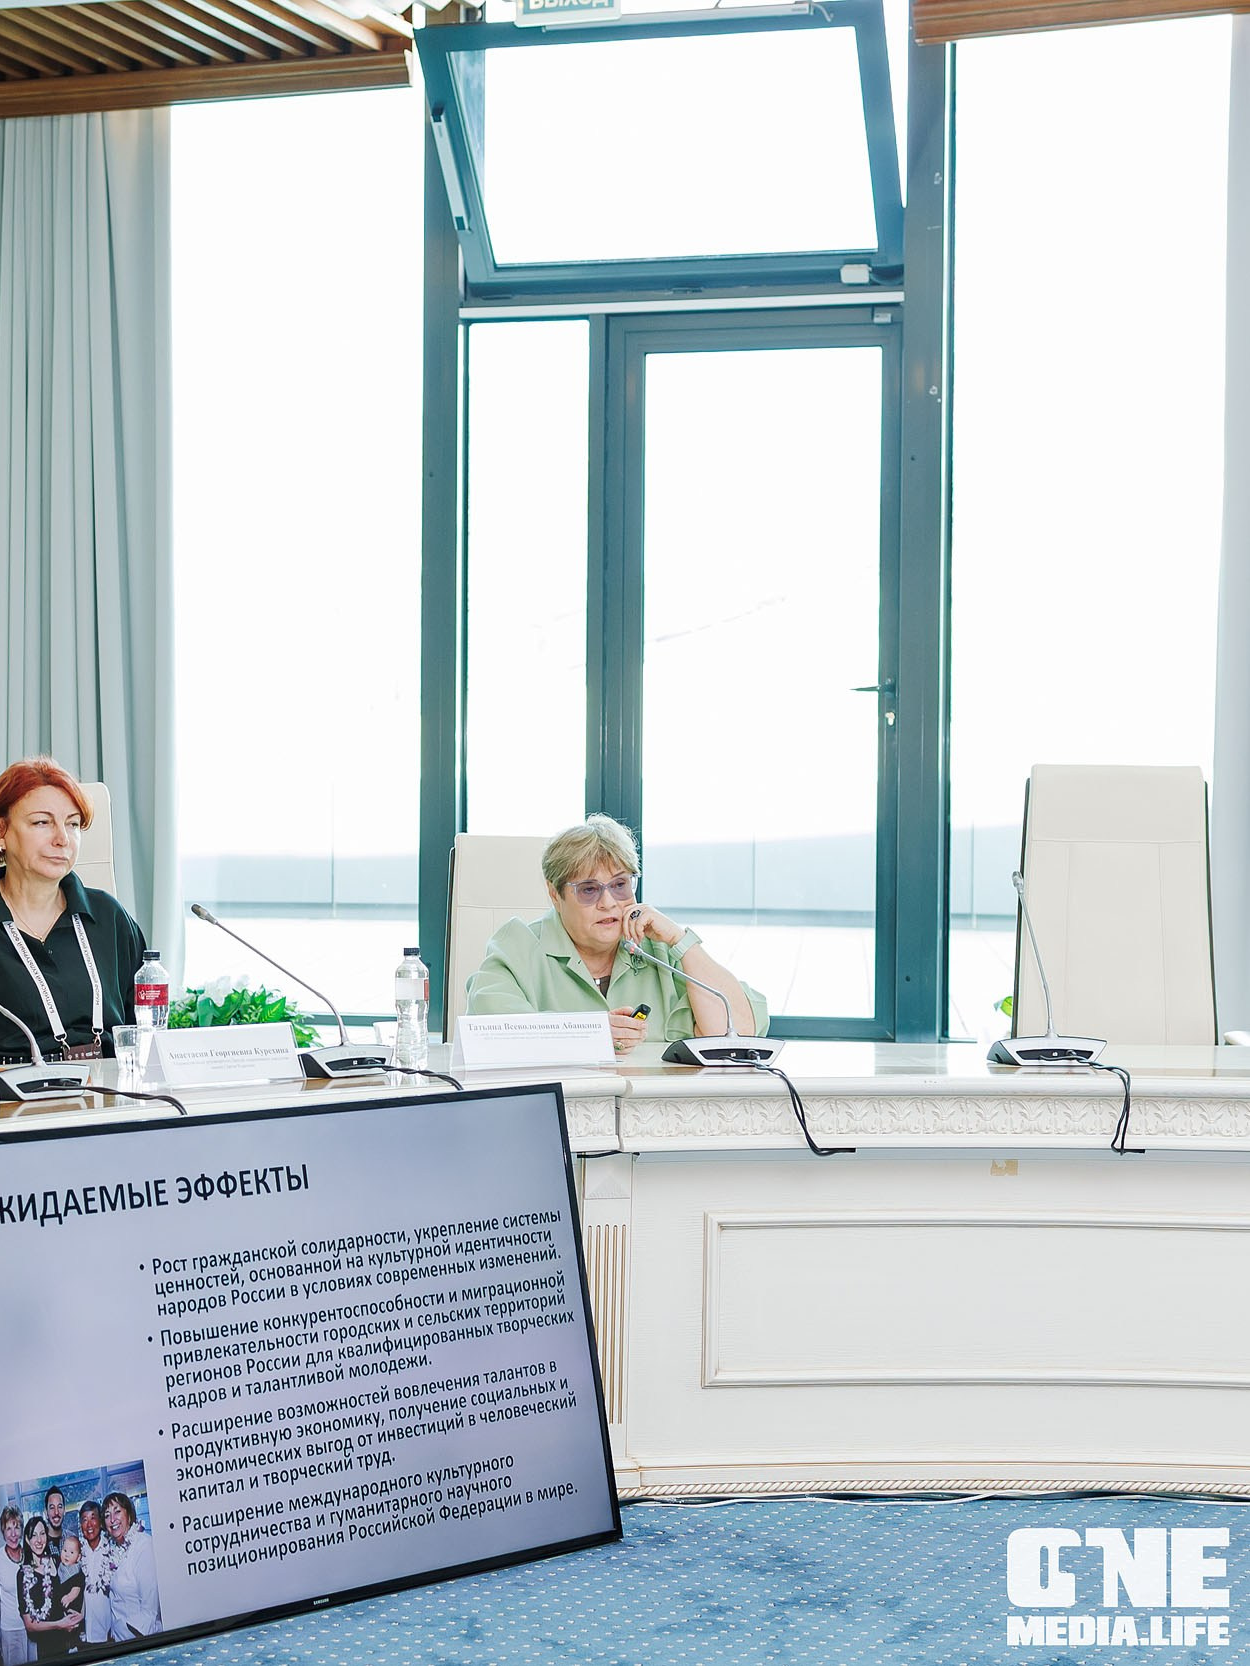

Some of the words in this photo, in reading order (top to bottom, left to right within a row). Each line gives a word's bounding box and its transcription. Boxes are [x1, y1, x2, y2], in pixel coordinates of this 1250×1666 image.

[209, 1049, 253, 1059] Георгиевна
[175, 1163, 309, 1204] ЭФФЕКТЫ
[152, 1258, 188, 1275] Рост
[192, 1239, 297, 1273] гражданской
[301, 1230, 411, 1256] солидарности,
[413, 1217, 500, 1245] укрепление
[502, 1210, 561, 1229] системы
[154, 1265, 245, 1299] ценностей,
[248, 1252, 342, 1283] основанной
[345, 1255, 364, 1270] на
[367, 1238, 452, 1270] культурной
[454, 1229, 554, 1257] идентичности
[157, 1294, 227, 1318] народов
[230, 1286, 286, 1306] России
[290, 1284, 299, 1297] в
[302, 1273, 373, 1300] условиях
[376, 1259, 476, 1286] современных
[479, 1243, 562, 1271] изменений.
[160, 1320, 259, 1346] Повышение
[263, 1292, 445, 1332] конкурентоспособности
[448, 1290, 458, 1304] и
[461, 1269, 565, 1302] миграционной
[163, 1331, 319, 1369] привлекательности
[323, 1318, 401, 1344] городских
[403, 1316, 414, 1329] и
[417, 1305, 482, 1328] сельских
[483, 1288, 566, 1319] территорий
[165, 1363, 243, 1392] регионов
[245, 1354, 301, 1375] России
[305, 1349, 334, 1369] для
[337, 1323, 495, 1364] квалифицированных
[496, 1310, 575, 1335] творческих
[167, 1387, 227, 1410] кадров
[231, 1385, 242, 1399] и
[244, 1362, 345, 1396] талантливой
[348, 1354, 432, 1379] молодежи.
[171, 1410, 273, 1440] Расширение
[277, 1384, 390, 1421] возможностей
[393, 1374, 481, 1401] вовлечения
[482, 1362, 546, 1385] талантов
[549, 1360, 557, 1373] в
[174, 1427, 293, 1463] продуктивную
[296, 1411, 385, 1439] экономику,
[388, 1395, 468, 1422] получение
[470, 1379, 557, 1407] социальных
[559, 1377, 569, 1390] и
[176, 1446, 303, 1480] экономических
[305, 1436, 355, 1457] выгод
[357, 1432, 374, 1447] от
[375, 1410, 465, 1444] инвестиций
[467, 1413, 477, 1427] в
[479, 1390, 577, 1424] человеческий
[179, 1478, 245, 1503] капитал
[248, 1475, 259, 1490] и
[262, 1452, 354, 1487] творческий
[356, 1450, 396, 1472] труд.
[182, 1500, 285, 1534] Расширение
[288, 1473, 423, 1512] международного
[426, 1455, 514, 1487] культурного
[185, 1516, 312, 1555] сотрудничества
[315, 1513, 326, 1528] и
[329, 1489, 442, 1527] гуманитарного
[446, 1475, 512, 1503] научного
[187, 1530, 345, 1576] позиционирования
[348, 1507, 436, 1542] Российской
[438, 1492, 522, 1522] Федерации
[525, 1491, 534, 1504] в
[537, 1482, 578, 1502] мире.
